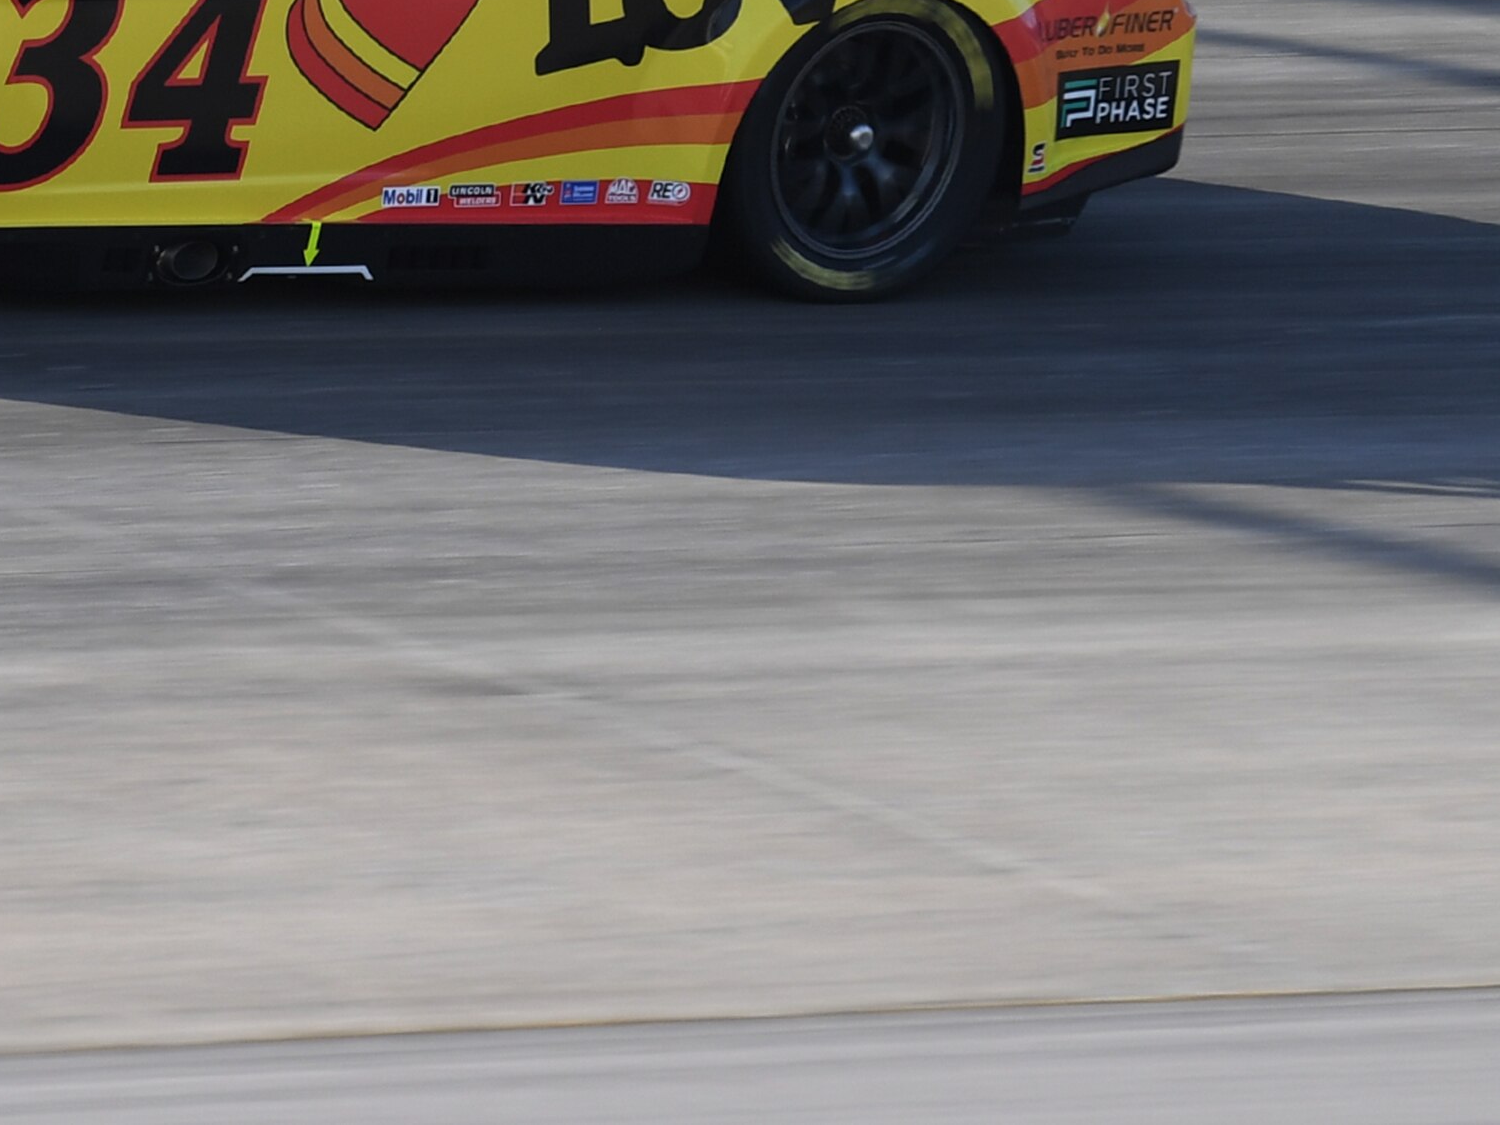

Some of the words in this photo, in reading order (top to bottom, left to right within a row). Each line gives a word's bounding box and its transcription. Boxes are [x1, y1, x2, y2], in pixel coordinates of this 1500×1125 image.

[1098, 71, 1173, 100] FIRST
[1095, 96, 1171, 124] PHASE
[382, 187, 423, 205] Mobil
[451, 186, 493, 196] LINCOLN
